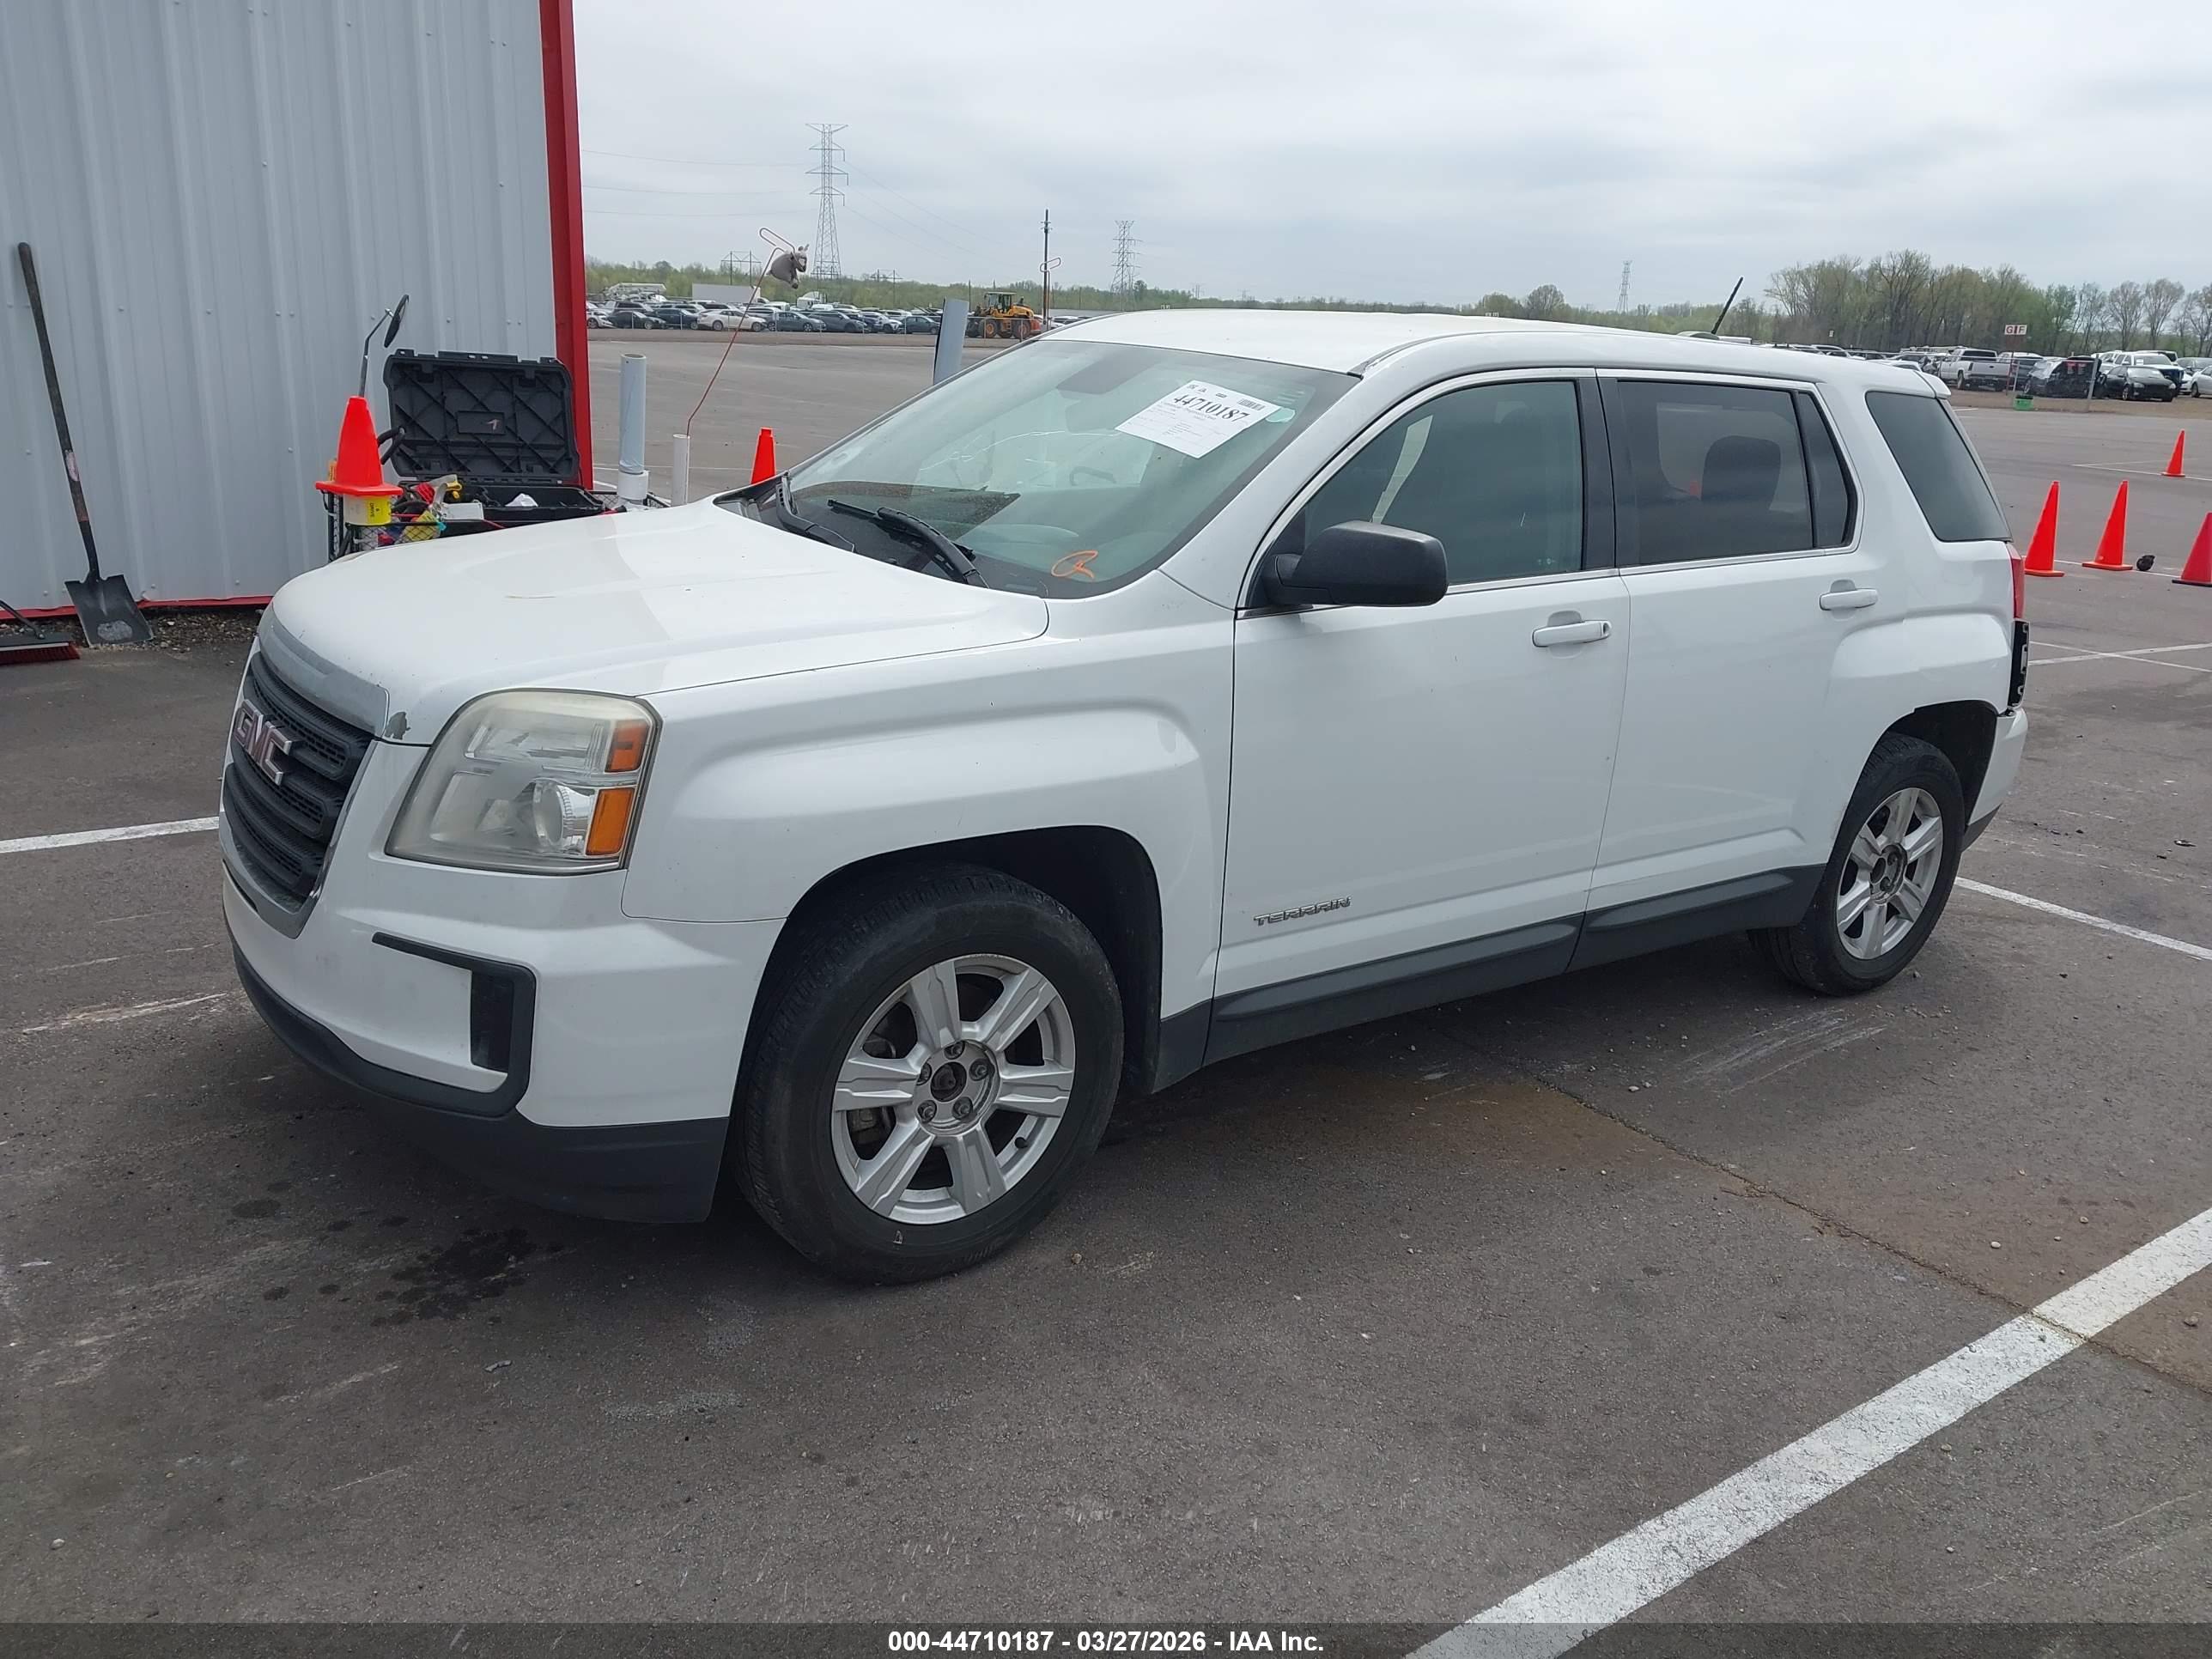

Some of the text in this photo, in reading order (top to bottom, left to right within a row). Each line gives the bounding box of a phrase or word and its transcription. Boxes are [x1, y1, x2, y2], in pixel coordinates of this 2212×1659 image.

[1174, 394, 1250, 422] 44710187
[233, 699, 292, 786] GMC
[1254, 896, 1352, 927] TERRAIN
